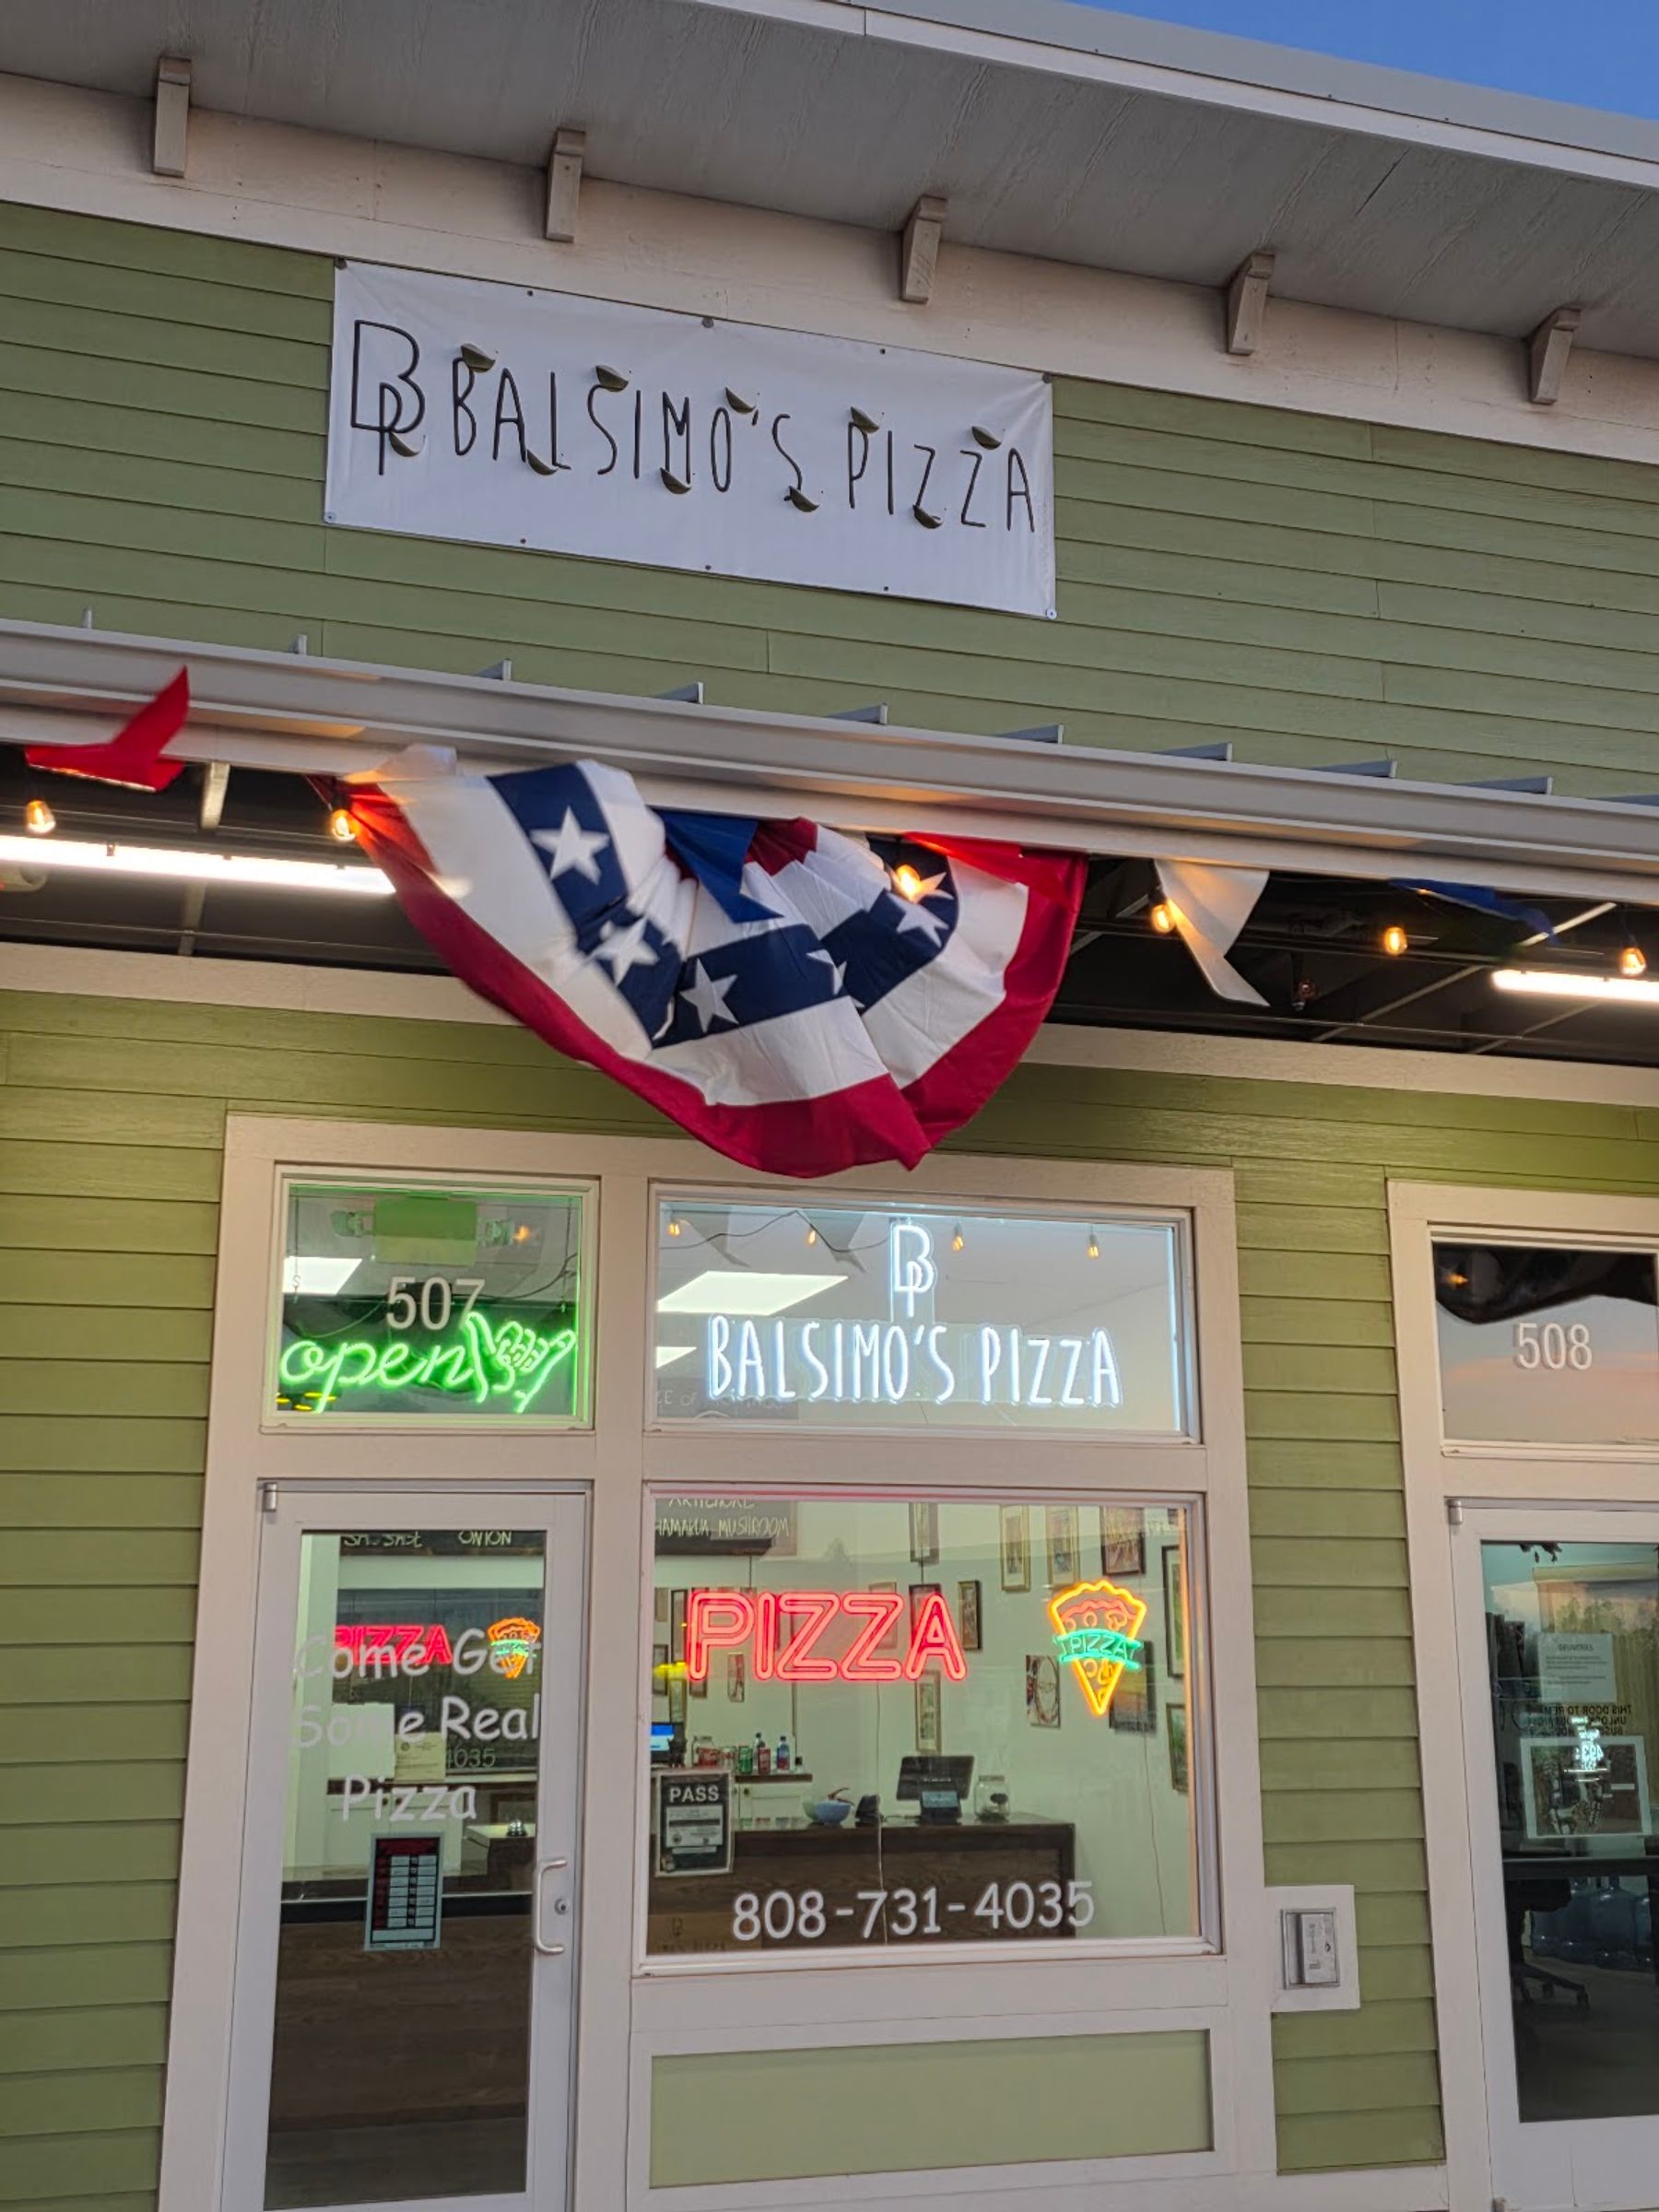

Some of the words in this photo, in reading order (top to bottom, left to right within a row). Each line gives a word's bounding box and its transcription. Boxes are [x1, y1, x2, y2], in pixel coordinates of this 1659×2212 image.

[452, 356, 803, 501] BALSIMO'S
[847, 420, 1036, 532] PIZZA
[386, 1276, 486, 1330] 507
[708, 1315, 955, 1402] BALSIMO'S
[981, 1327, 1121, 1405] PIZZA
[1517, 1322, 1593, 1371] 508
[280, 1340, 474, 1414] open
[718, 1514, 790, 1538] MUSHROOM
[296, 1634, 429, 1679] Come
[688, 1590, 968, 1681] PIZZA
[1069, 1633, 1128, 1659] PIZZA
[295, 1704, 426, 1748] Soe
[441, 1692, 540, 1741] Real
[342, 1773, 477, 1822] Pizza
[669, 1783, 720, 1803] PASS
[732, 1880, 1096, 1941] 808-731-4035
